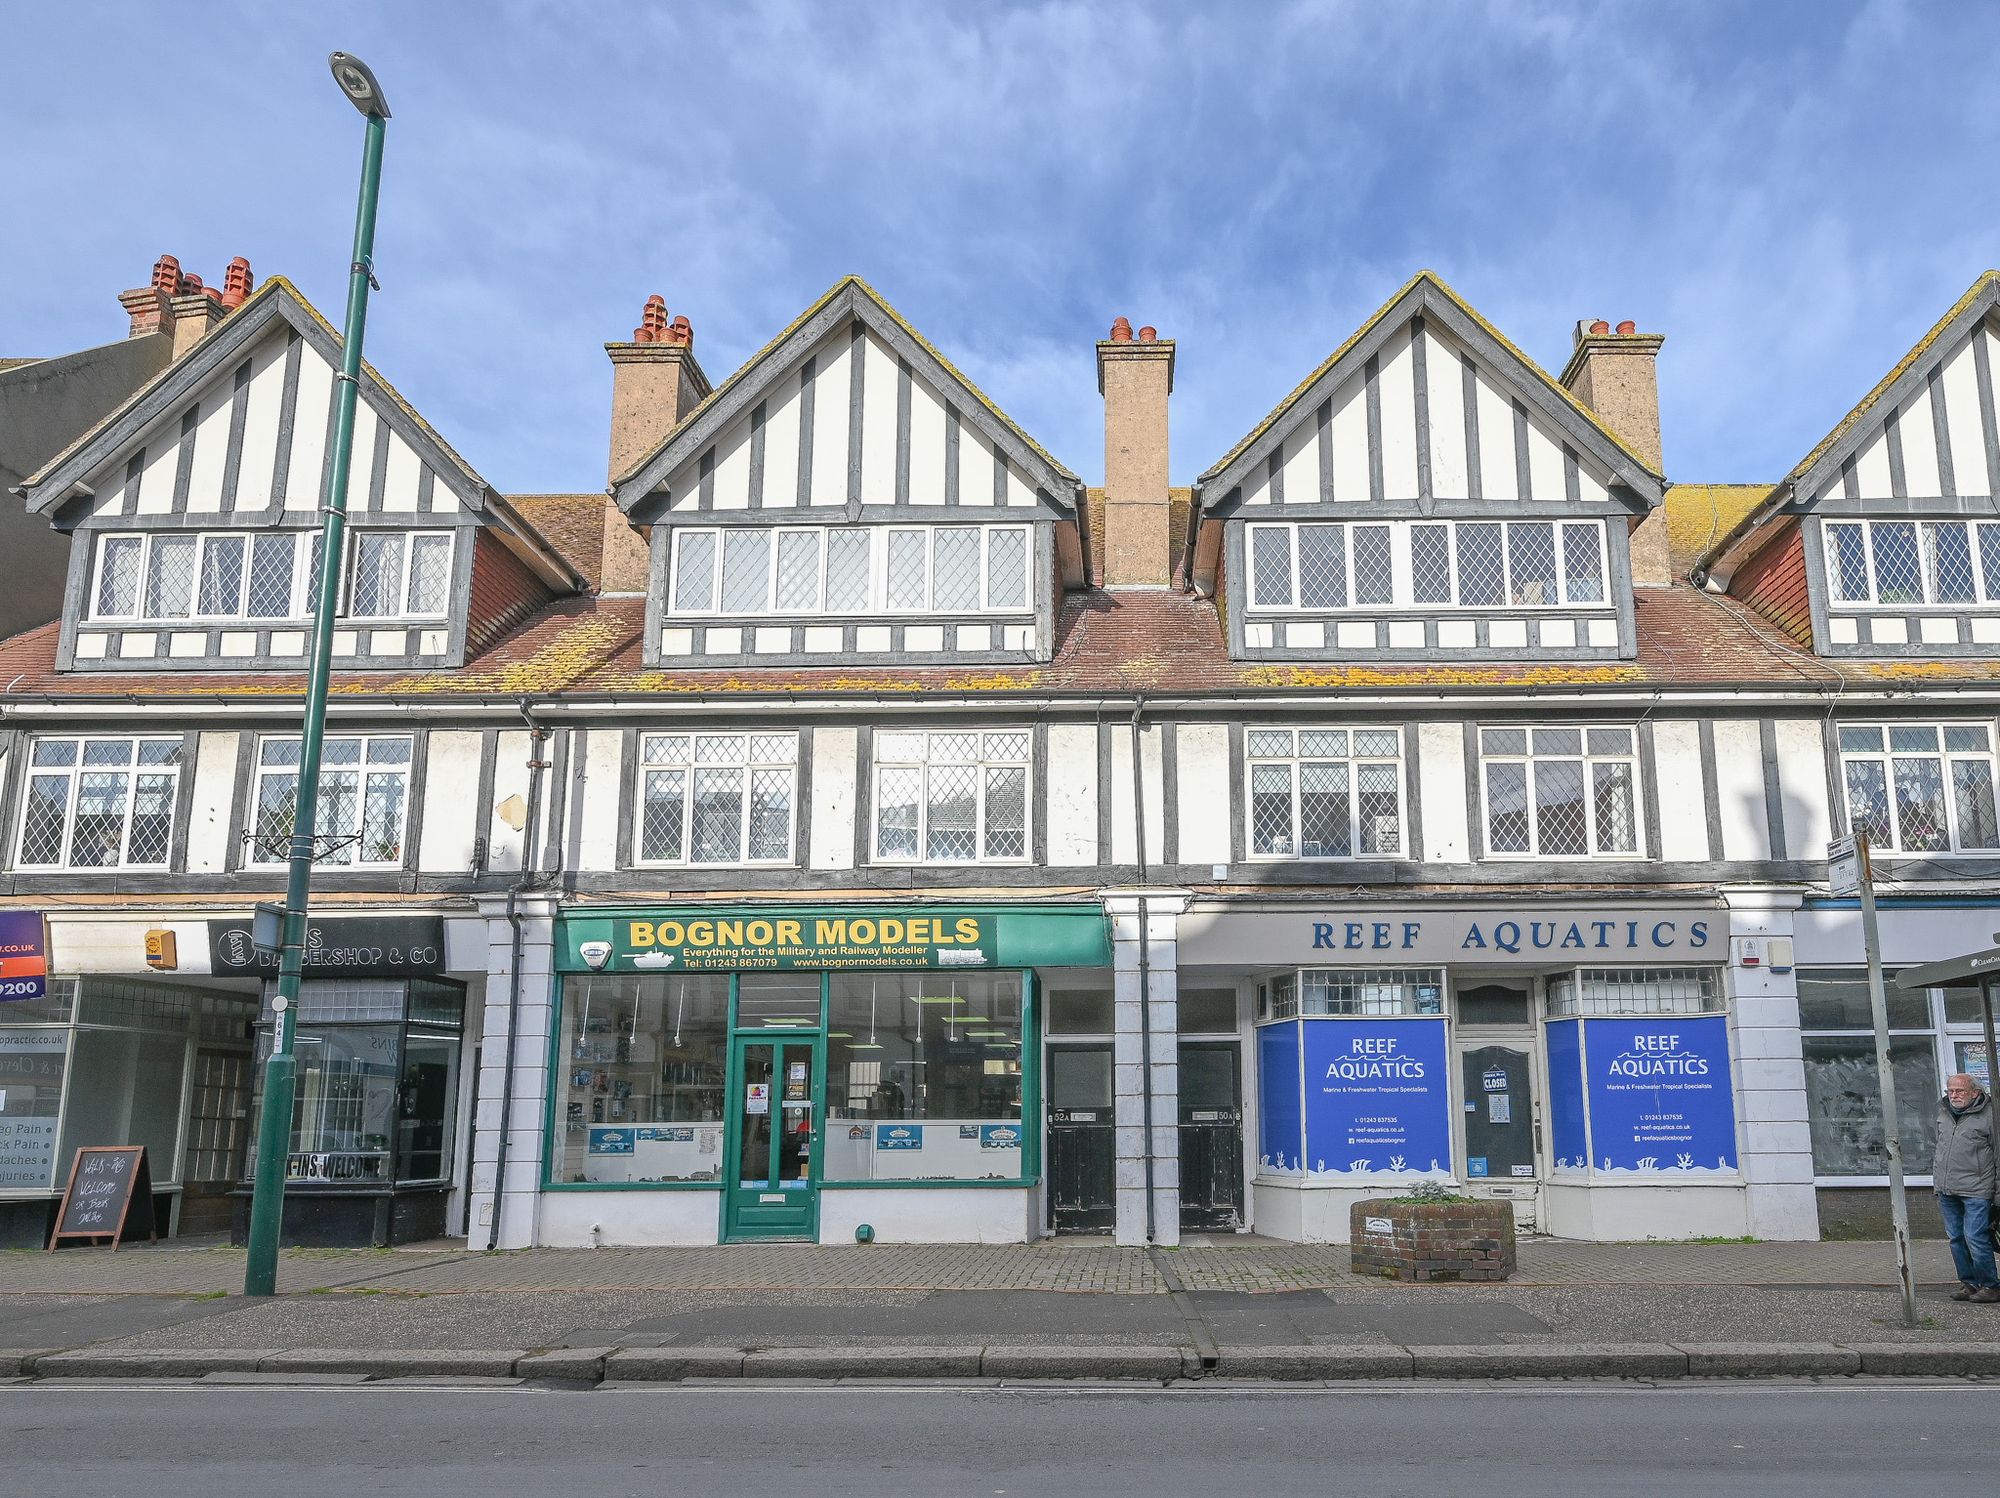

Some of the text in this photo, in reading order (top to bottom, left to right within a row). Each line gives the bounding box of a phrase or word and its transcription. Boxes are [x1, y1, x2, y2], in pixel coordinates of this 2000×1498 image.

[629, 918, 980, 947] BOGNOR MODELS
[1312, 921, 1709, 954] REEF AQUATICS
[259, 946, 438, 967] BABERSHOP & CO
[682, 945, 929, 958] Everything for the Military and Railway Modeller
[683, 956, 929, 968] Tel: 01243 867079 www.bognormodels.co.uk
[1352, 1038, 1397, 1054] REEF
[1634, 1035, 1680, 1051] REEF
[1325, 1062, 1425, 1081] AQUATICS
[1608, 1058, 1709, 1078] AQUATICS
[1378, 1085, 1398, 1093] Tropical
[1400, 1085, 1428, 1093] Specialists
[1484, 1078, 1507, 1089] CLOSED
[1662, 1083, 1683, 1091] Tropical
[1684, 1083, 1713, 1091] Specialists
[1054, 1112, 1070, 1121] 52A
[1218, 1111, 1233, 1120] 50A
[16, 1124, 41, 1134] Pain
[14, 1139, 39, 1150] Pain
